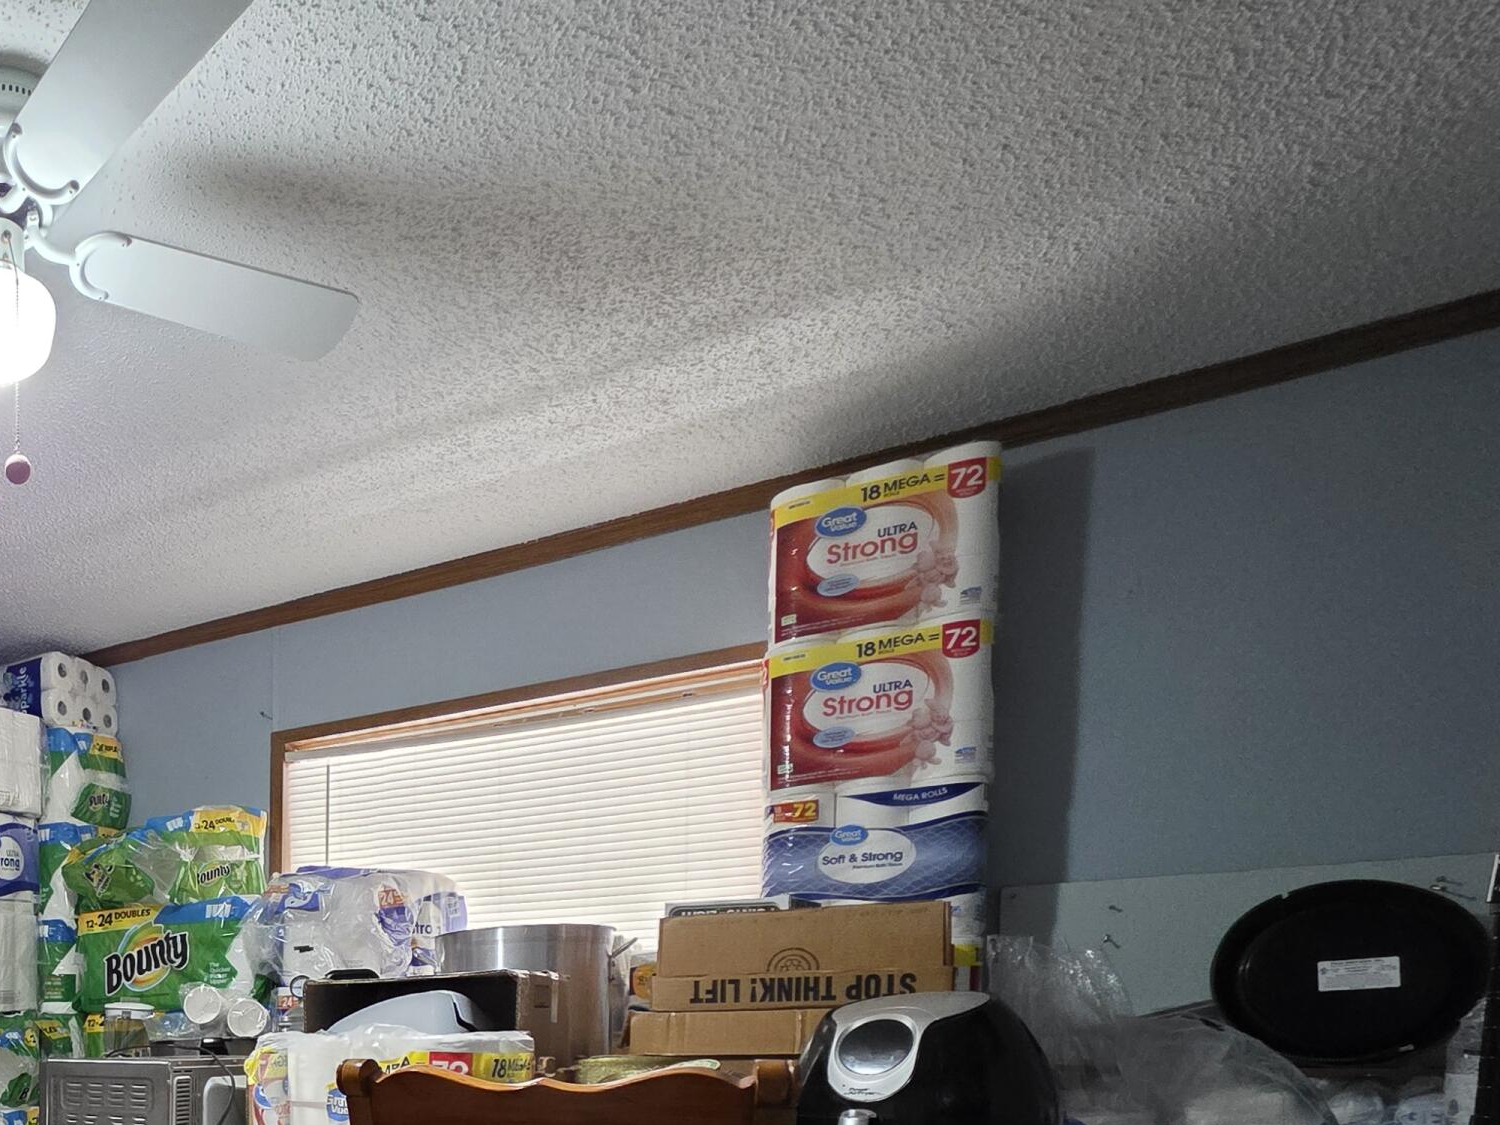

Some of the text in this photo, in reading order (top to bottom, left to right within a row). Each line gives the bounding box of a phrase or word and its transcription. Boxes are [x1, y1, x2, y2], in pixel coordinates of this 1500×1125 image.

[861, 485, 881, 501] 18
[884, 473, 931, 492] MEGA
[950, 464, 983, 489] 72
[821, 512, 857, 528] Great
[877, 521, 918, 538] ULTRA
[826, 532, 918, 565] Strong
[856, 641, 877, 659] 18
[878, 632, 925, 650] MEGA
[944, 626, 977, 650] 72
[816, 667, 852, 682] Great
[873, 678, 913, 695] ULTRA
[822, 689, 913, 717] Strong
[893, 787, 948, 802] MEGA ROLLS
[793, 802, 817, 818] 72
[822, 850, 903, 866] Soft & Strong
[114, 908, 151, 920] DOUBLES
[105, 932, 189, 996] Bounty
[690, 972, 917, 1004] STOP THINK! LIFT
